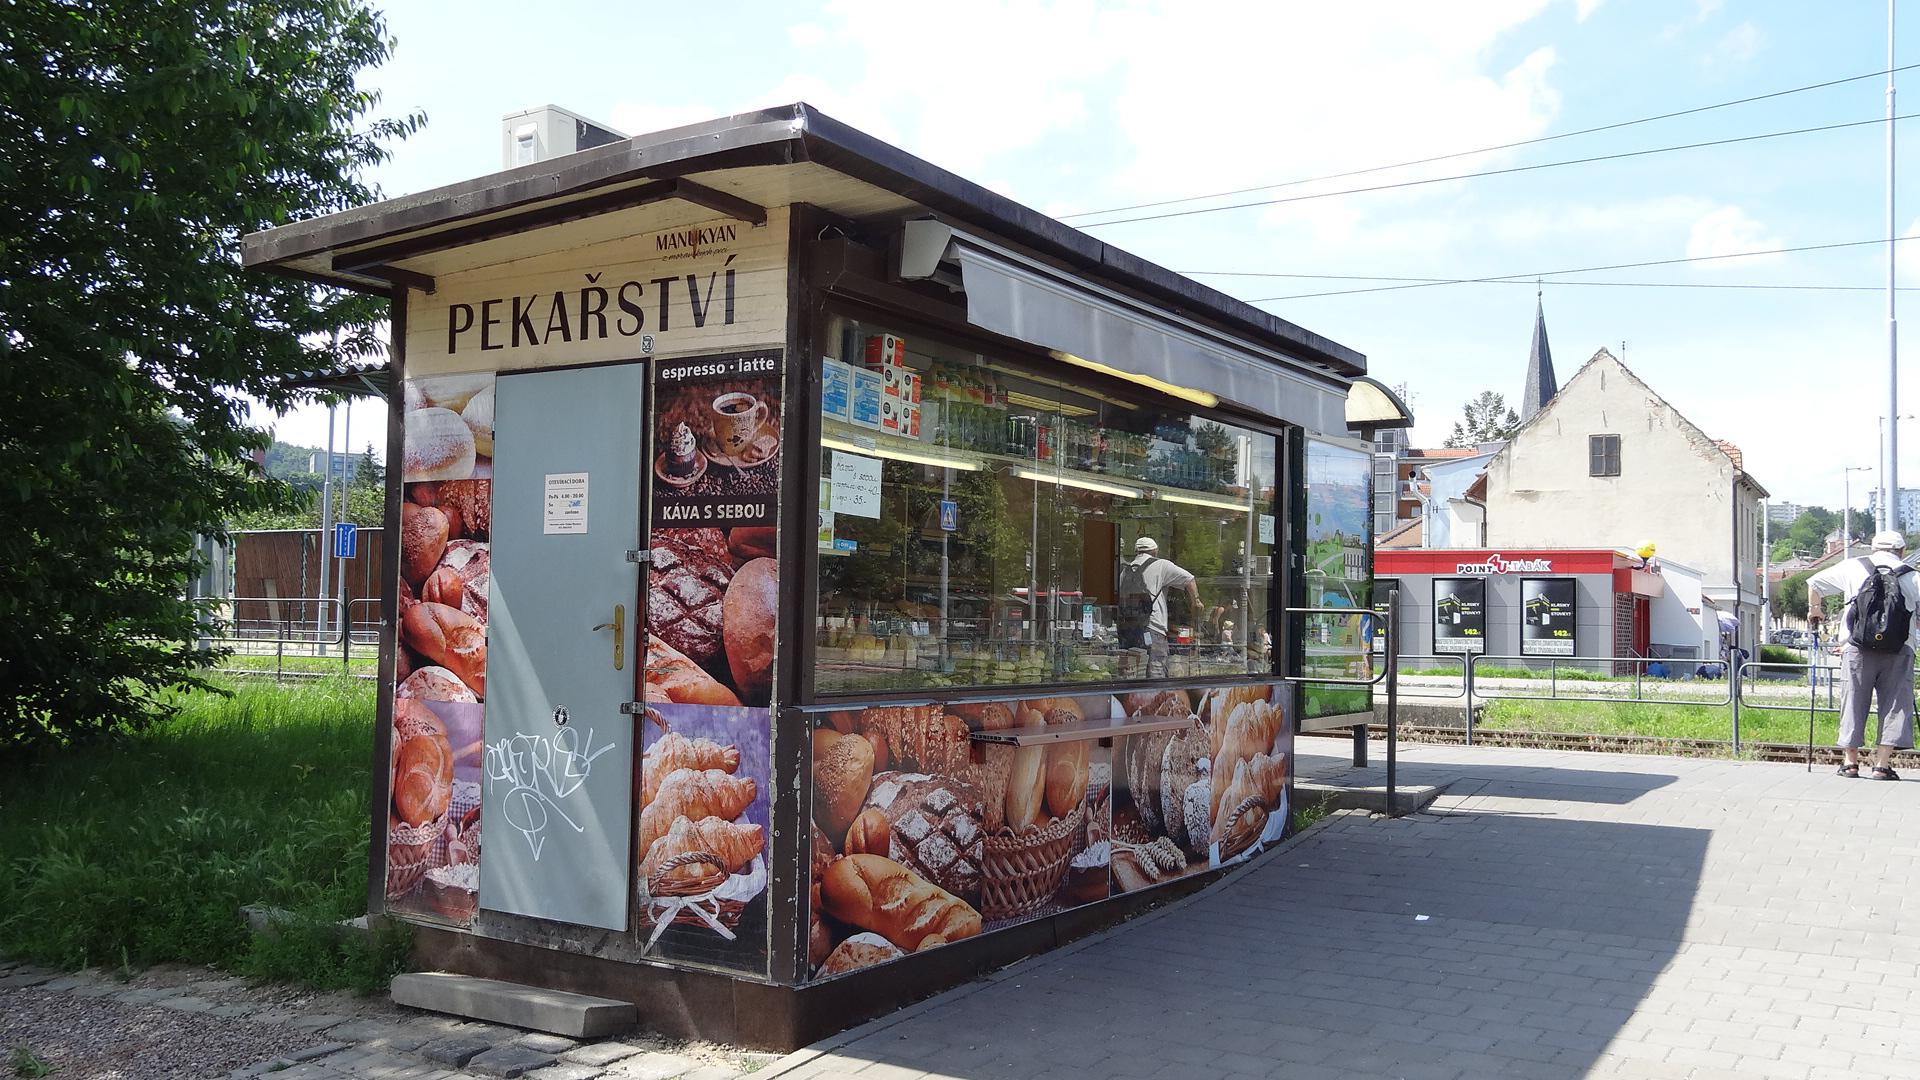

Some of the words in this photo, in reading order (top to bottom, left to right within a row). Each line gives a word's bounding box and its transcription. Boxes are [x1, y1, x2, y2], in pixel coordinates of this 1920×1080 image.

[656, 224, 736, 251] MANUKYAN
[448, 254, 737, 354] PEKAŘSTVÍ
[662, 363, 726, 381] espresso
[738, 357, 775, 372] latte
[663, 502, 700, 520] KÁVA
[704, 505, 712, 519] S
[717, 503, 765, 519] SEBOU
[1458, 565, 1493, 573] POINT
